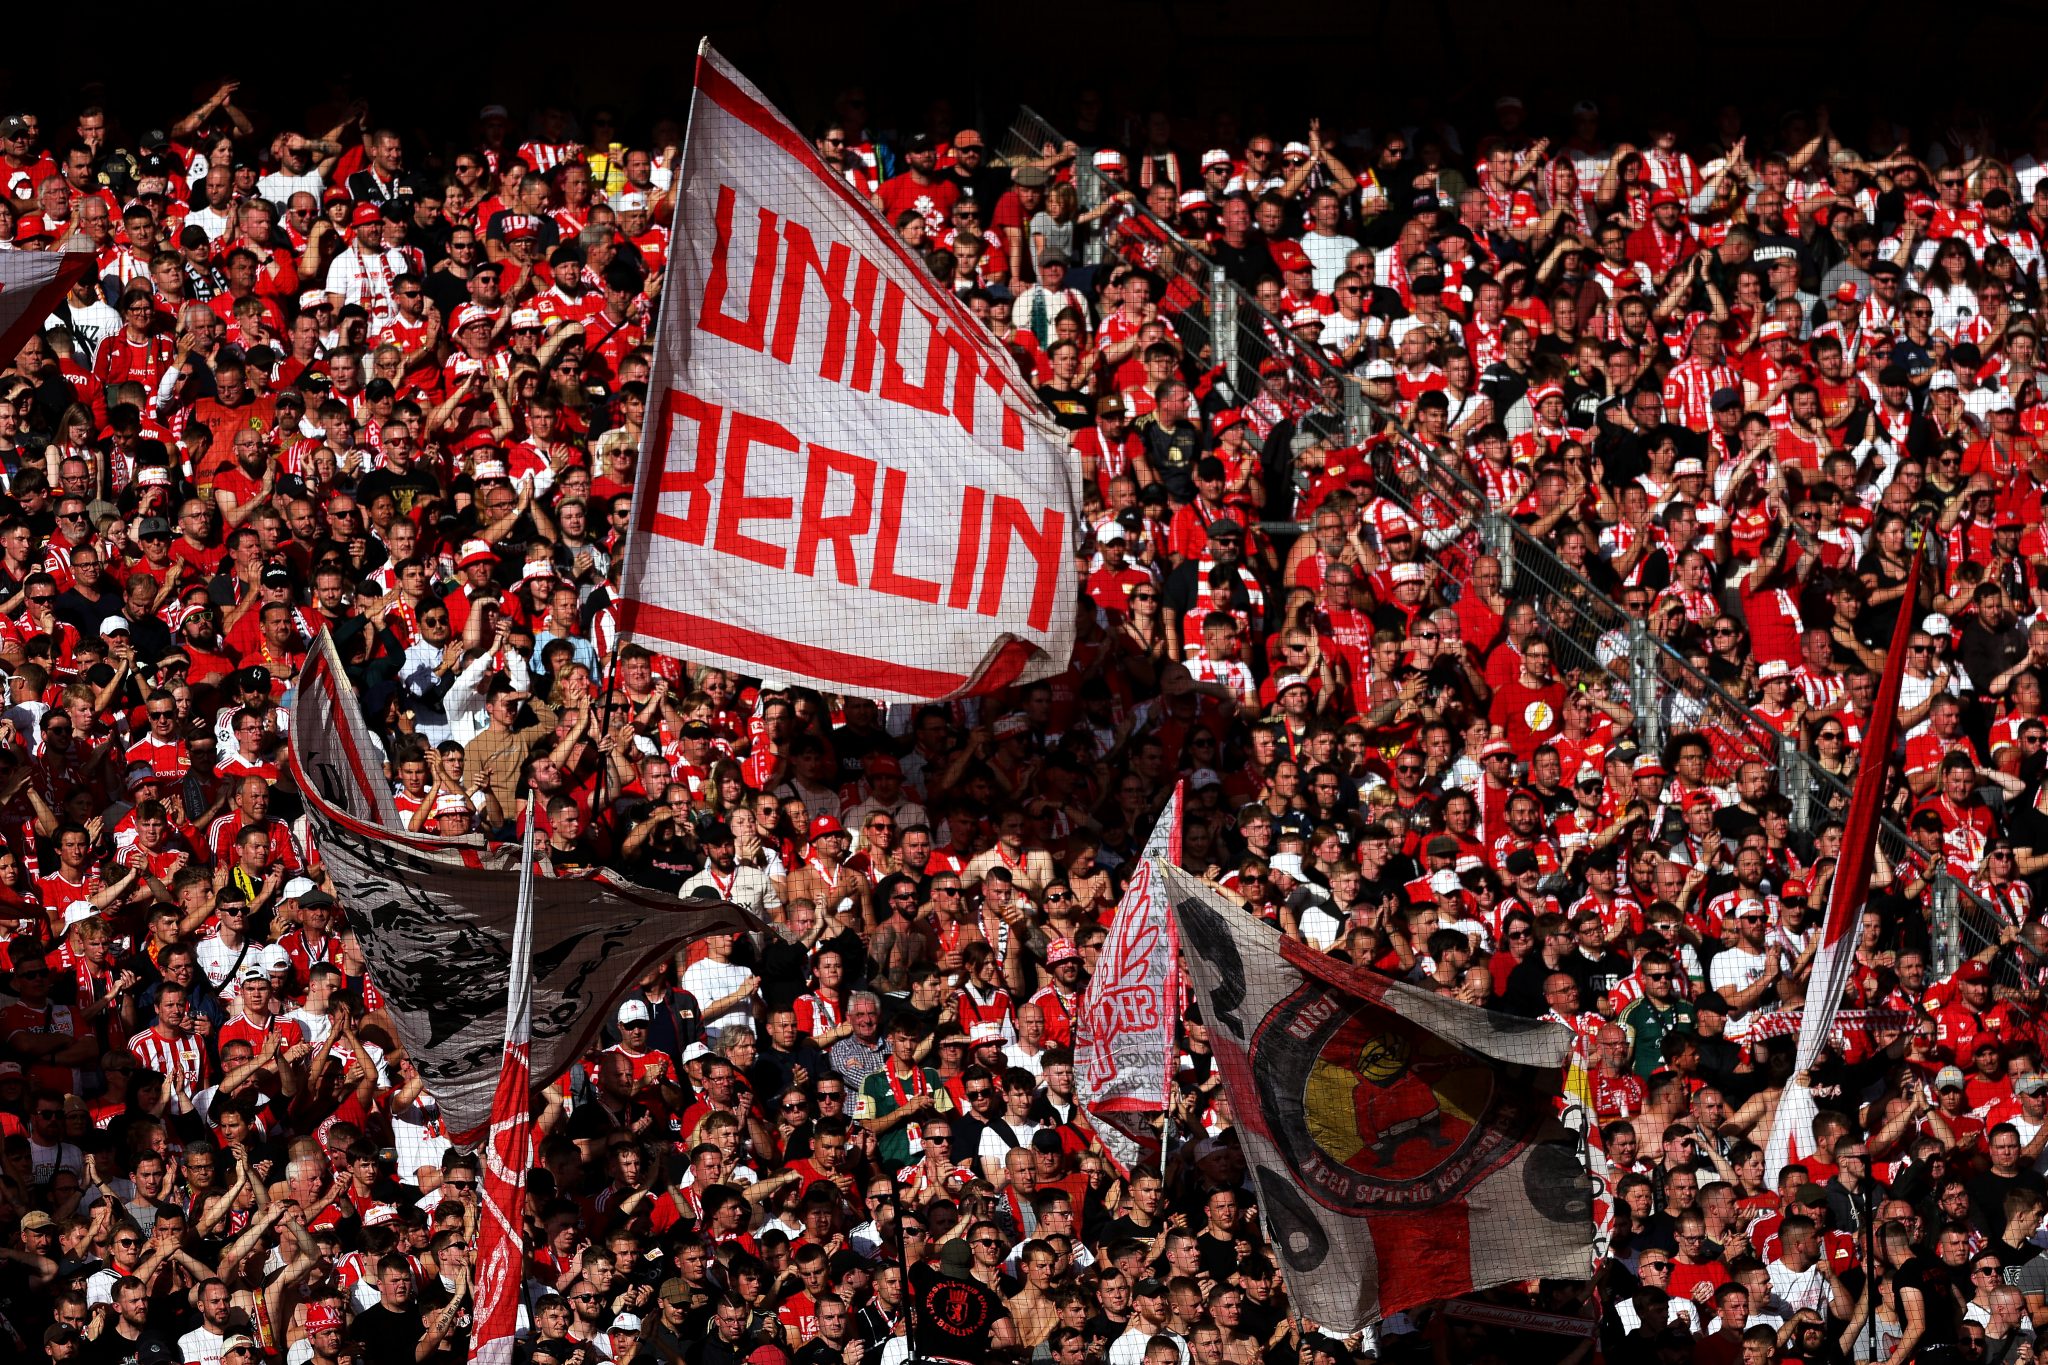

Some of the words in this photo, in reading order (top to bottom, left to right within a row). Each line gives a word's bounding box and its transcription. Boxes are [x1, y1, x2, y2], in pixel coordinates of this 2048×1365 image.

[697, 184, 1024, 452] UNION
[638, 388, 1065, 634] BERLIN
[207, 972, 229, 984] MELLO
[936, 1318, 974, 1337] BERLIN
